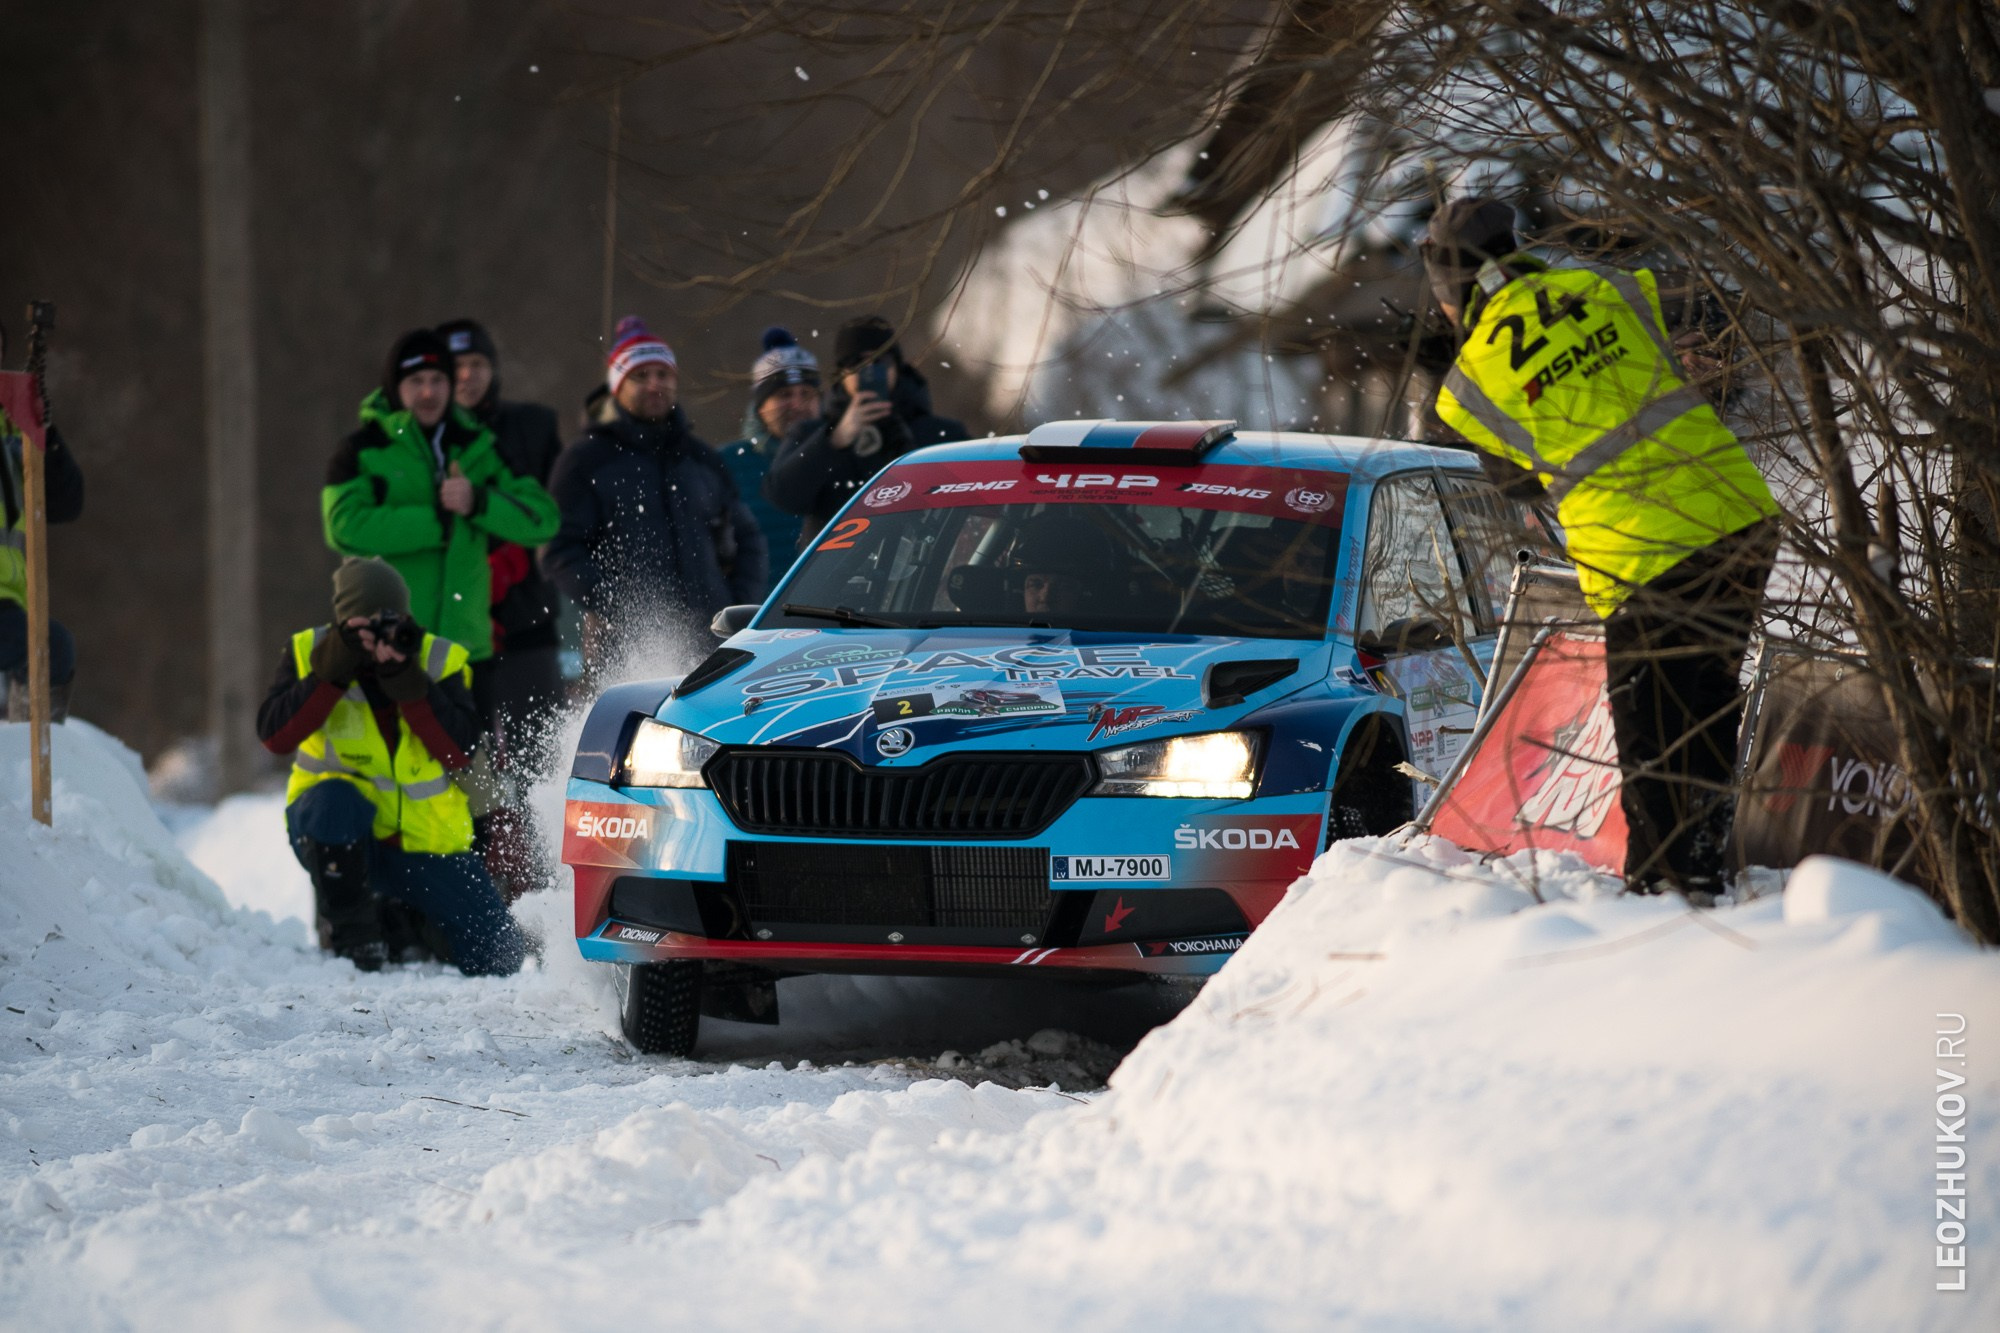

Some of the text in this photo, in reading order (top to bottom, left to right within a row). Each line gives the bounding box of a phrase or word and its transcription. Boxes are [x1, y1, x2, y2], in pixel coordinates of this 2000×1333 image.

[1486, 288, 1589, 372] 24
[1527, 321, 1619, 402] ASMG
[1581, 345, 1630, 379] MEDIA
[929, 480, 1018, 495] ASMG
[1182, 483, 1272, 499] ASMG
[816, 517, 871, 551] 2
[742, 644, 1151, 703] SPACE
[1000, 666, 1196, 681] TRAVEL
[897, 701, 913, 715] 2
[576, 811, 648, 839] ŠKODA
[1173, 823, 1300, 850] ŠKODA
[1075, 858, 1163, 877] MJ-7900
[619, 926, 660, 943] YOKOHAMA
[1169, 937, 1244, 953] YOKOHAMA
